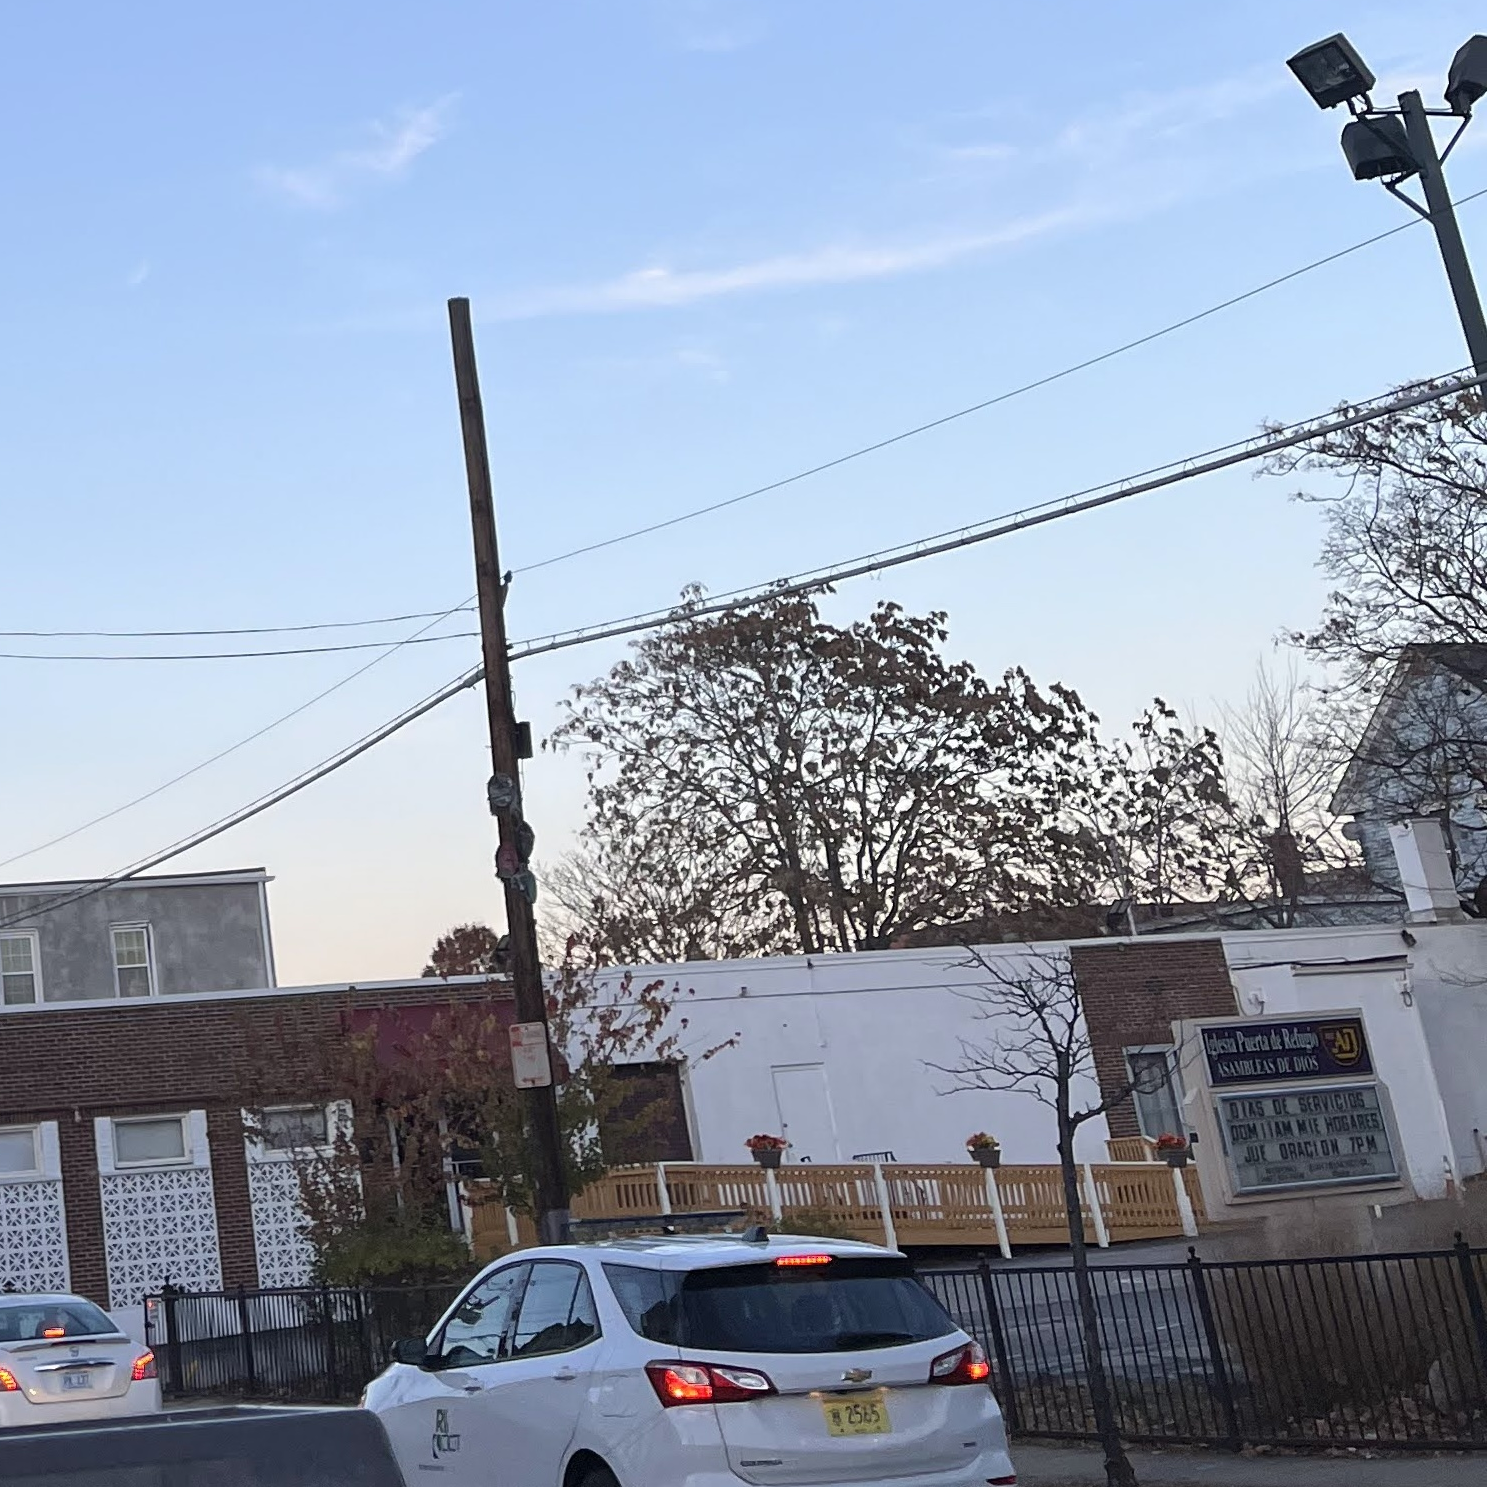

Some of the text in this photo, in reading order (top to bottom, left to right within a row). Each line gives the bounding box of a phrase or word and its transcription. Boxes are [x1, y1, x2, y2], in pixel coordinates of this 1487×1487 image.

[1204, 1026, 1320, 1060] Iglesia Puerta de Refugio
[1217, 1055, 1319, 1077] ASAMBLEAS DE DIOS
[1272, 1097, 1290, 1115] DE
[1298, 1092, 1365, 1114] SERVICIOS
[1324, 1113, 1381, 1134] HOGARES
[1278, 1138, 1340, 1160] ORACION
